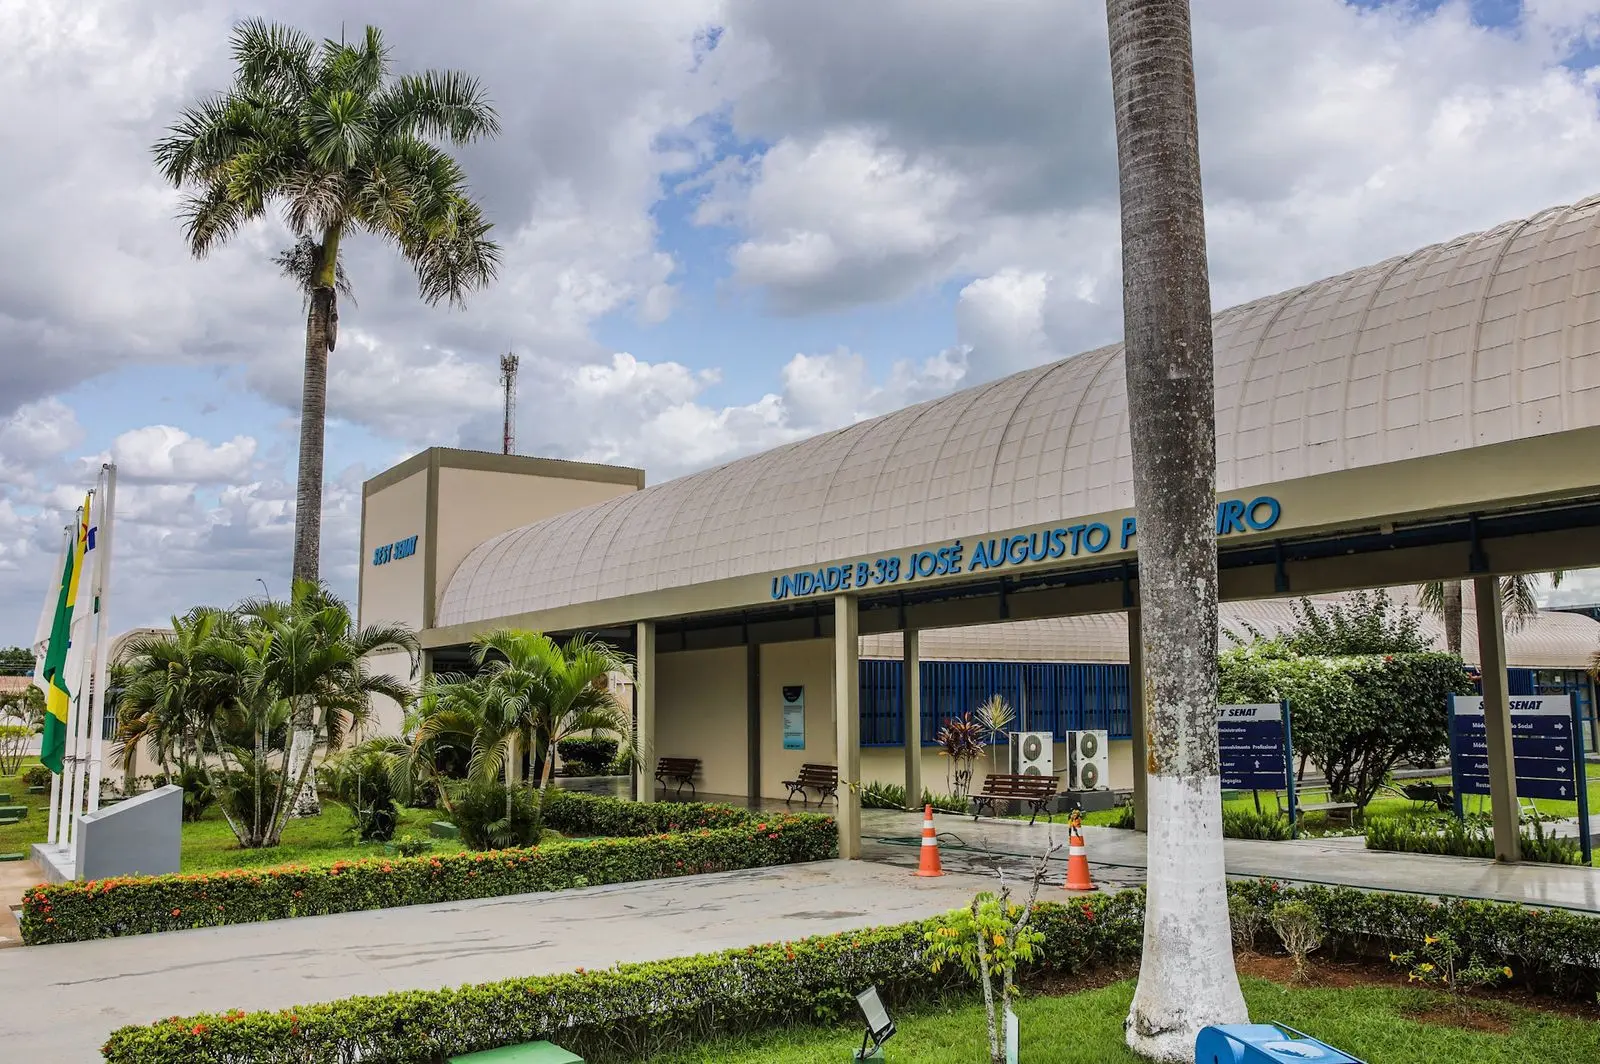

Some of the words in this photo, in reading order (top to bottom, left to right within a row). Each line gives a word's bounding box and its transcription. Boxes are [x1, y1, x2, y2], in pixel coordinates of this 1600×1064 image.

[770, 564, 853, 600] UNIDADE
[855, 556, 900, 587] B-38
[904, 540, 963, 581] JOSÉ
[968, 522, 1112, 571] AUGUSTO
[1509, 700, 1543, 710] SENAT
[1228, 708, 1257, 717] SENAT
